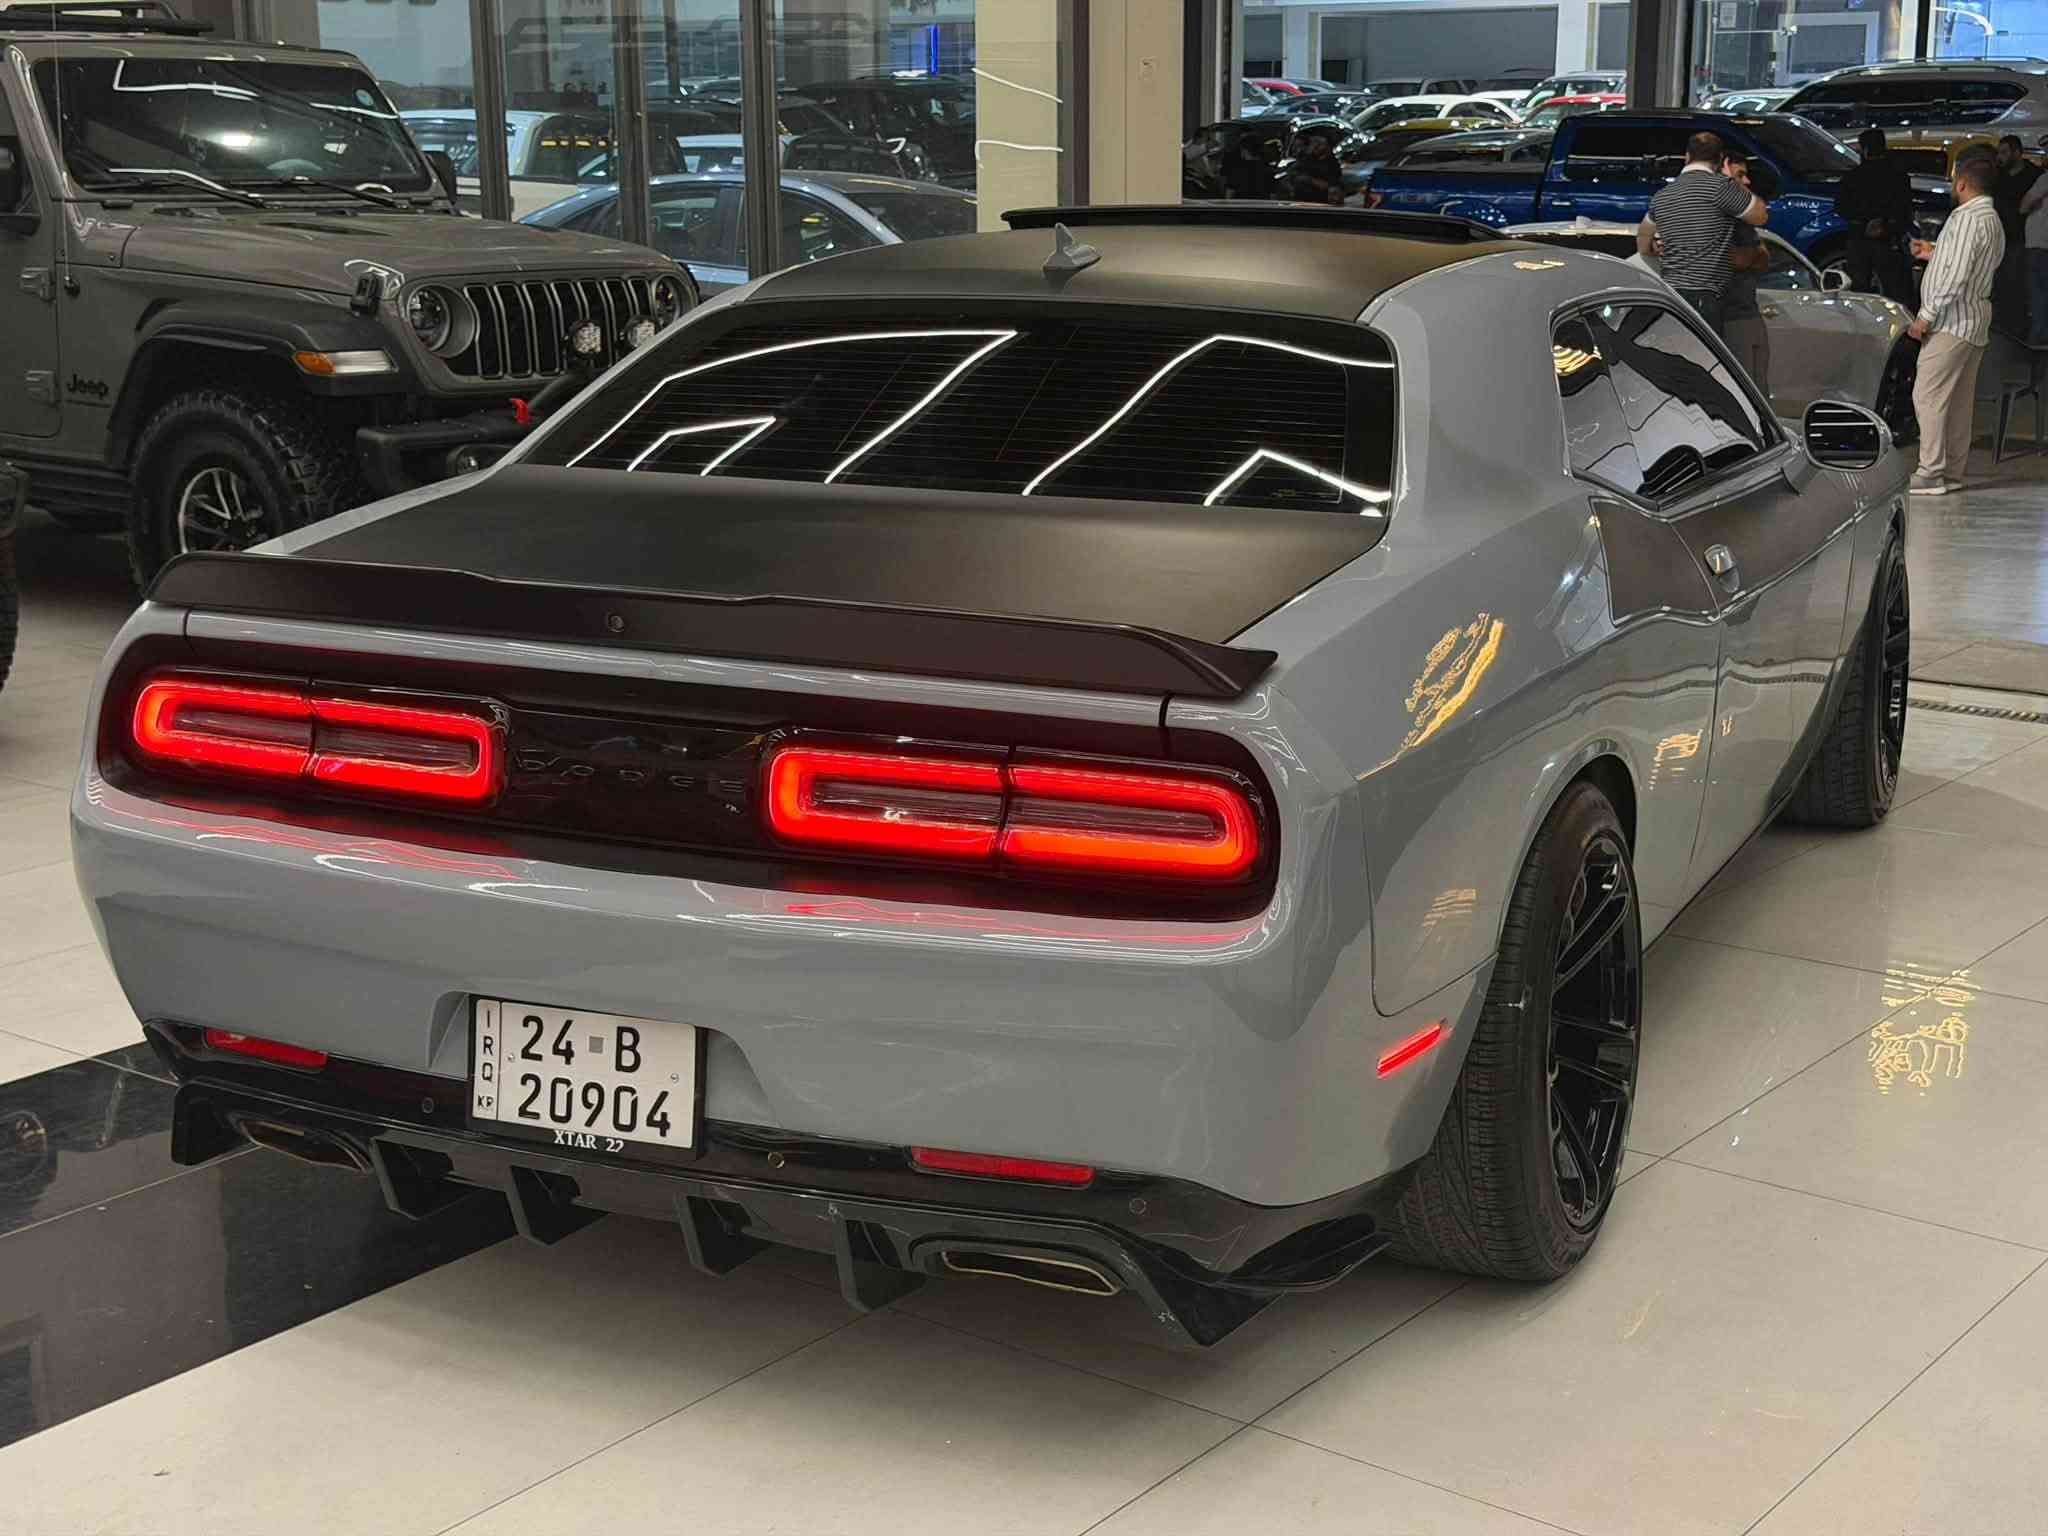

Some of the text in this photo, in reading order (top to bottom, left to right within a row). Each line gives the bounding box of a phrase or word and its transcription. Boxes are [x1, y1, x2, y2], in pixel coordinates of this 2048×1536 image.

[66, 374, 109, 400] Jeep
[520, 1015, 641, 1073] 24 B
[518, 1073, 671, 1138] 20904
[553, 1129, 598, 1149] XTAR
